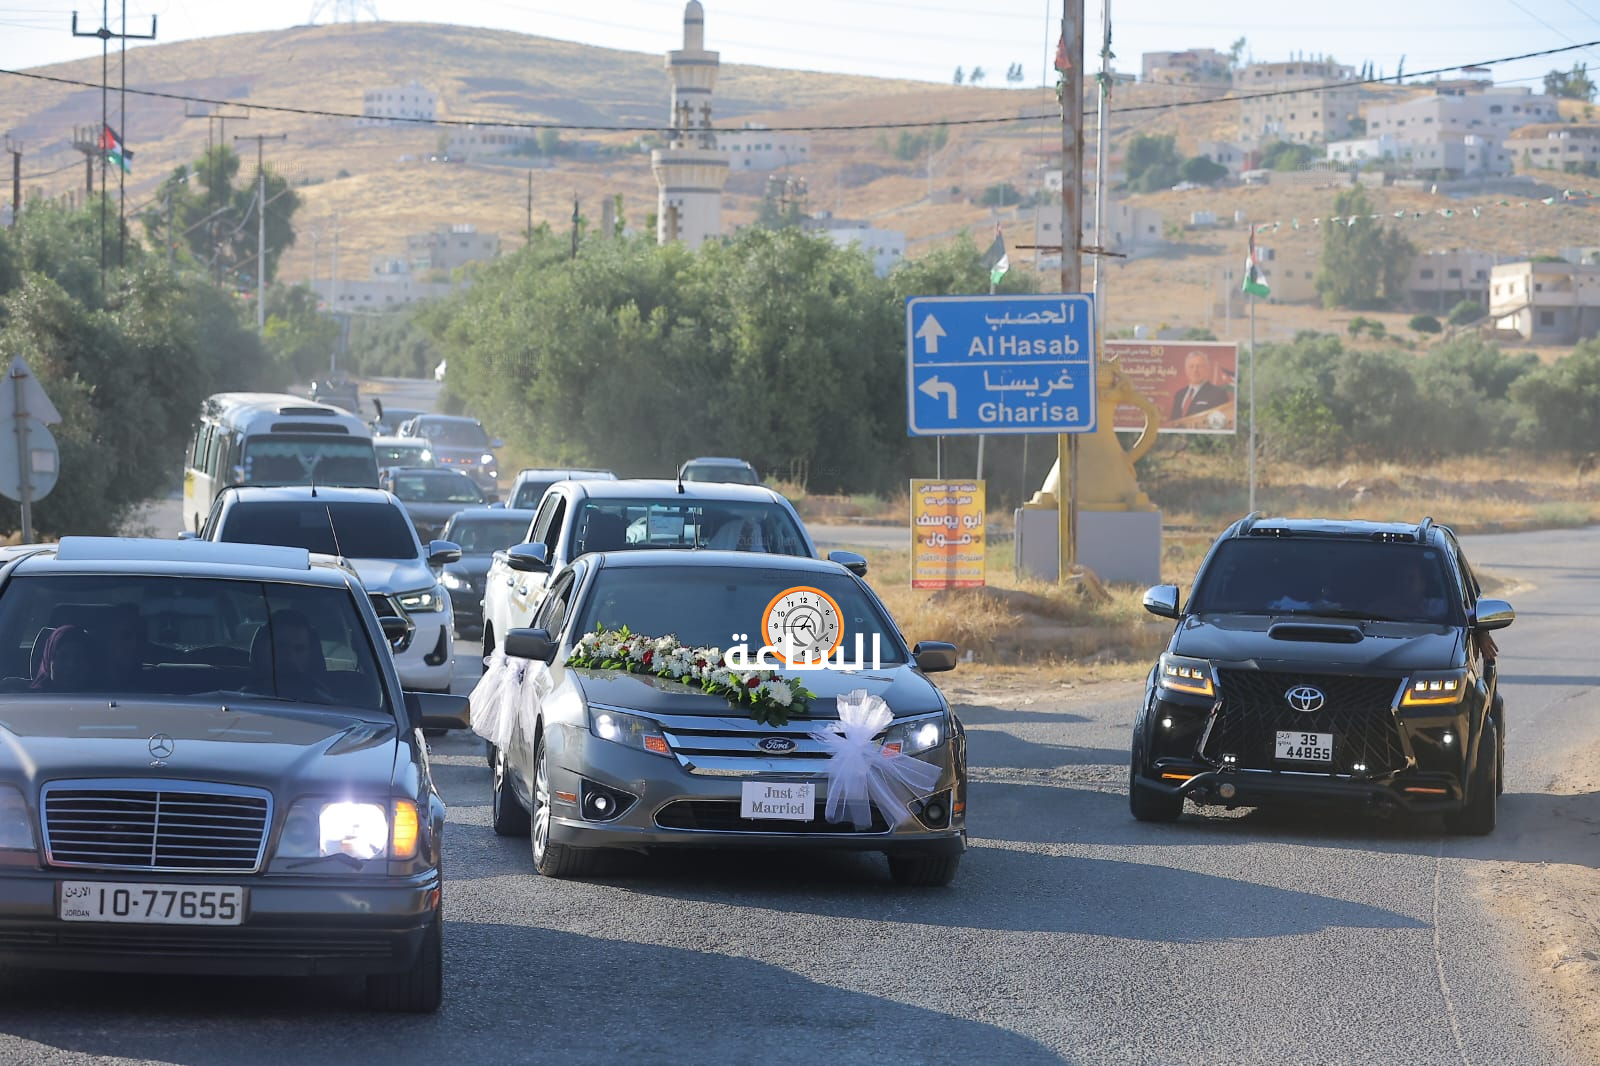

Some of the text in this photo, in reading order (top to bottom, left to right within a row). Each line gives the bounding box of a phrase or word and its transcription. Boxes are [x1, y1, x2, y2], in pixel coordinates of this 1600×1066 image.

[985, 302, 1075, 331] الحصب
[968, 335, 1080, 357] Al Hasab
[983, 368, 1074, 397] غريسا
[978, 402, 1079, 423] Gharisa
[916, 512, 960, 529] يوسف
[766, 739, 789, 750] Ford
[1300, 733, 1318, 746] 39
[1286, 746, 1330, 760] 44855
[764, 786, 793, 799] Just
[752, 801, 805, 815] Married
[64, 909, 90, 918] JORDAN
